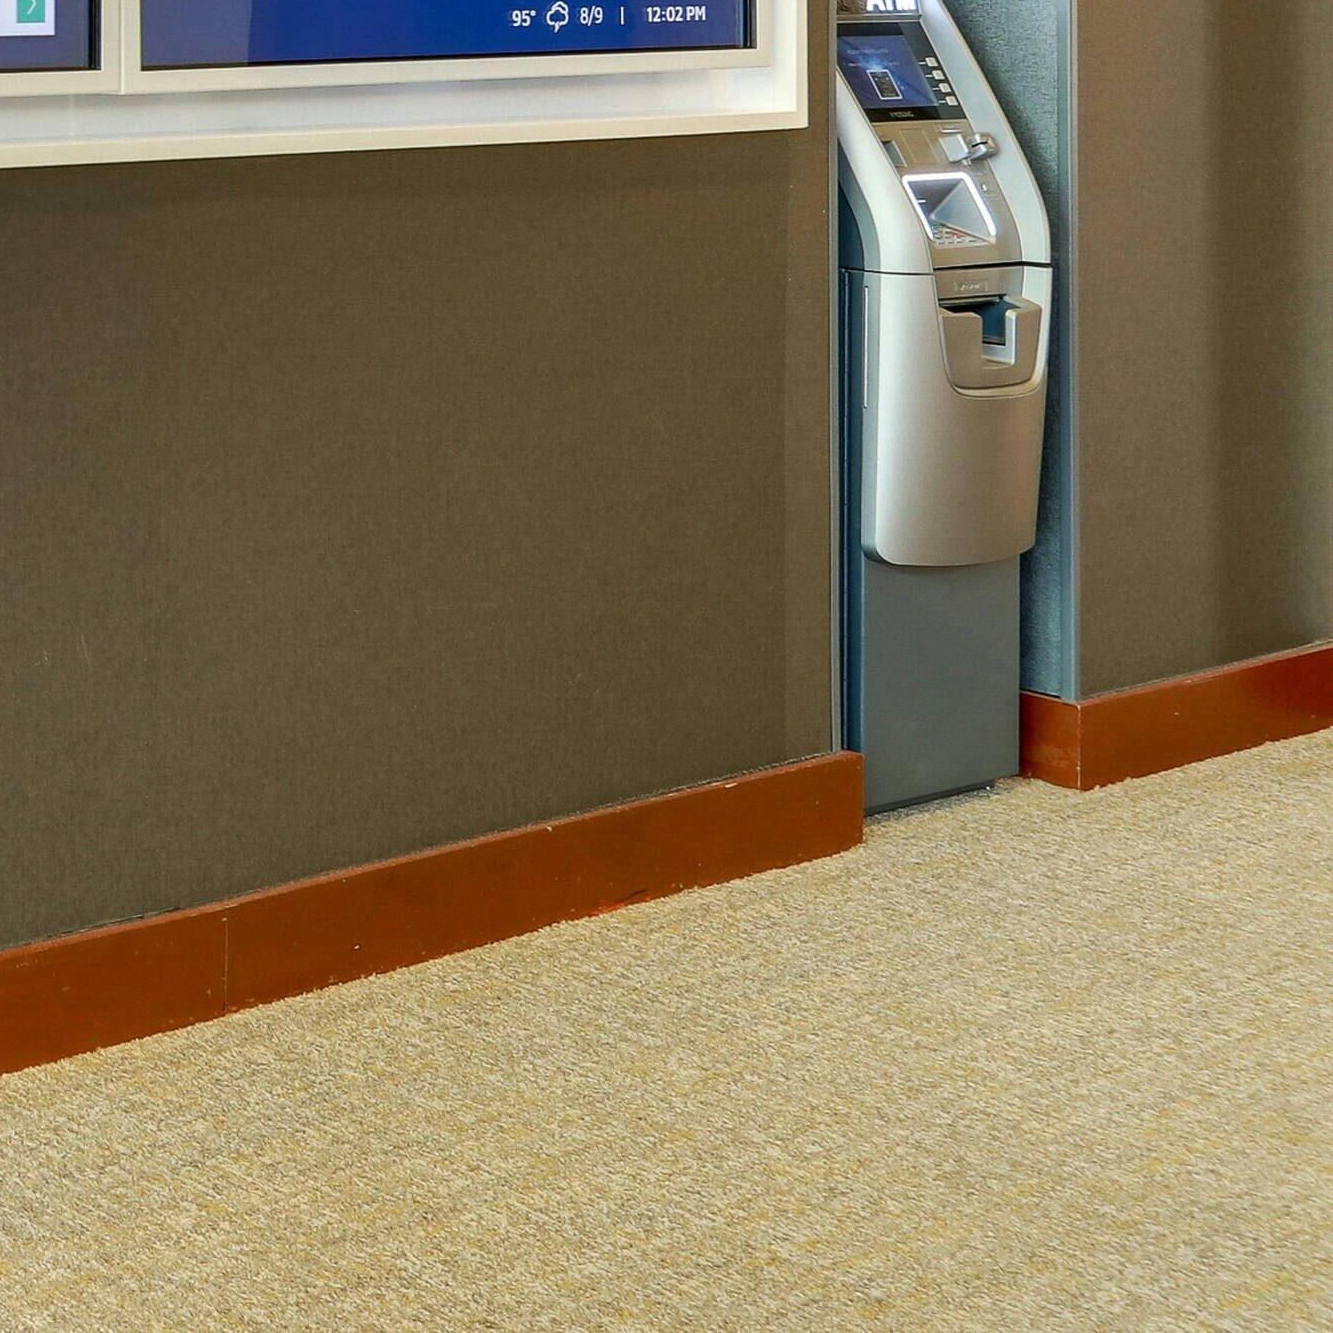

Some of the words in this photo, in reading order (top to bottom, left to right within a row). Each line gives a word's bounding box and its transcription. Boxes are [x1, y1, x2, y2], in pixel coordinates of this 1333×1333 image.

[579, 5, 603, 26] 8/9
[646, 6, 683, 23] 12:02
[686, 5, 707, 21] PM
